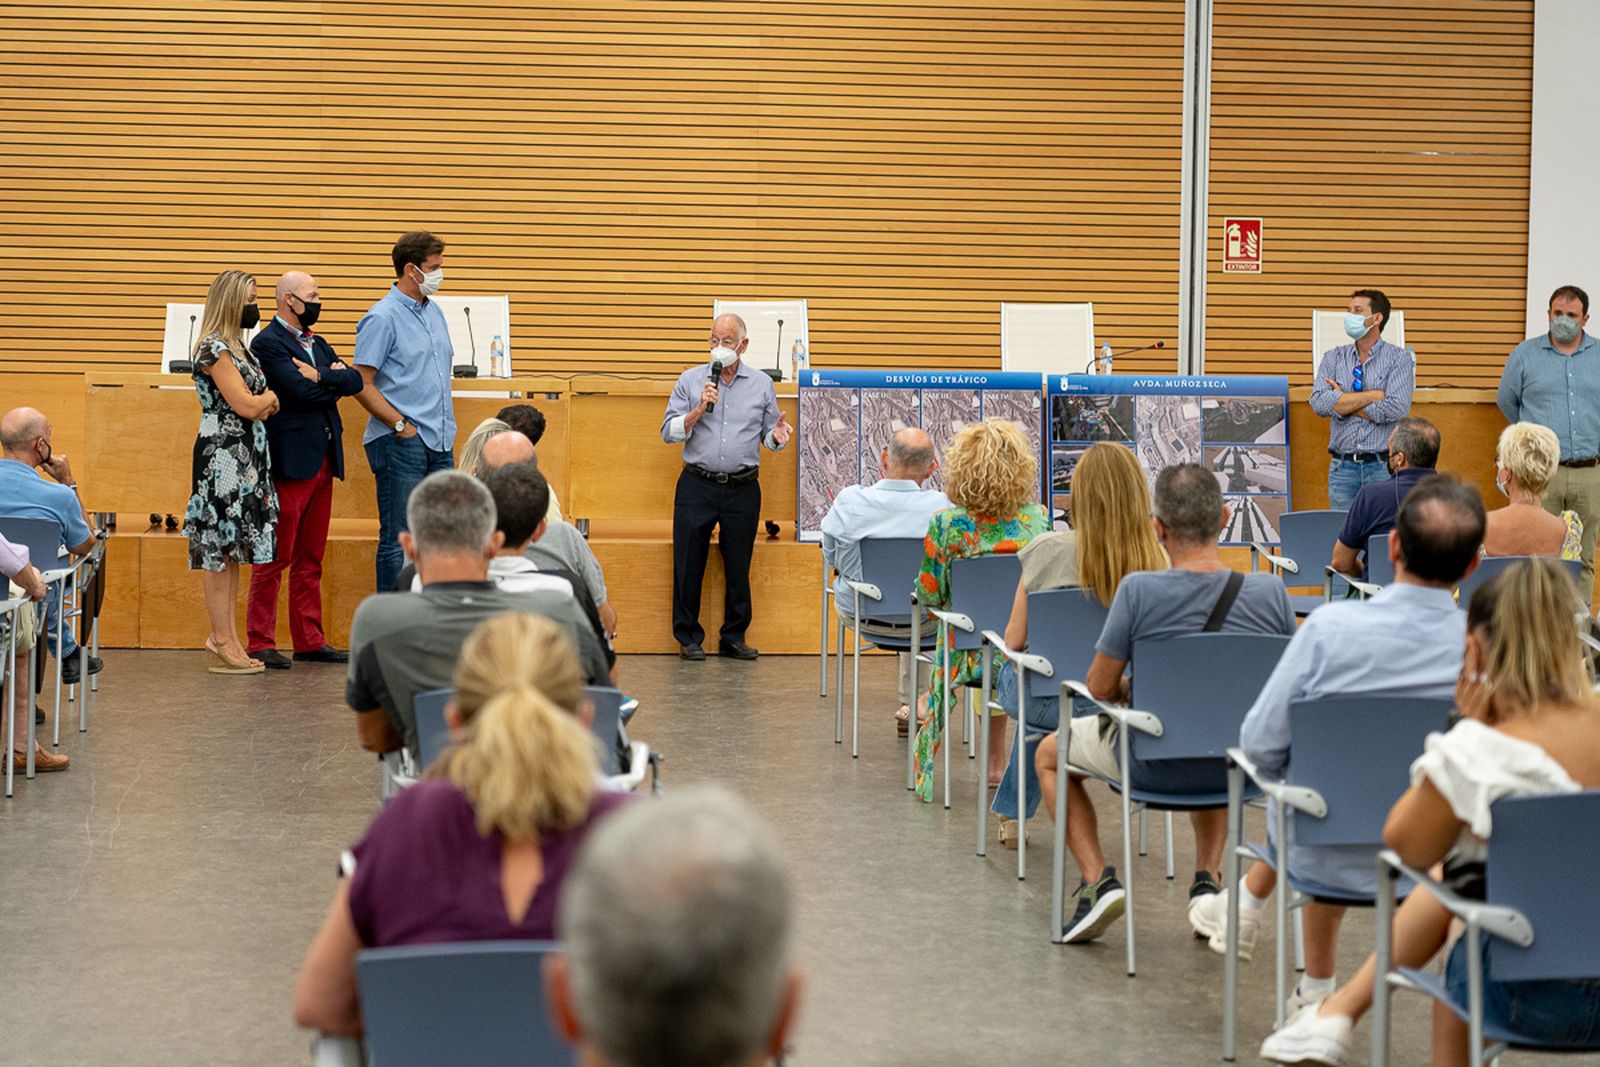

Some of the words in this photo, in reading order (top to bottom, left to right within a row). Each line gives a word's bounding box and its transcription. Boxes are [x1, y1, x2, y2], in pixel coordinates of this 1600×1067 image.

[885, 374, 928, 384] DESVÍOS
[930, 375, 943, 384] DE
[945, 374, 988, 384] TRÁFICO
[1132, 379, 1164, 388] AVDA.
[1165, 378, 1201, 388] MUÑOZ
[1203, 380, 1227, 388] SECA
